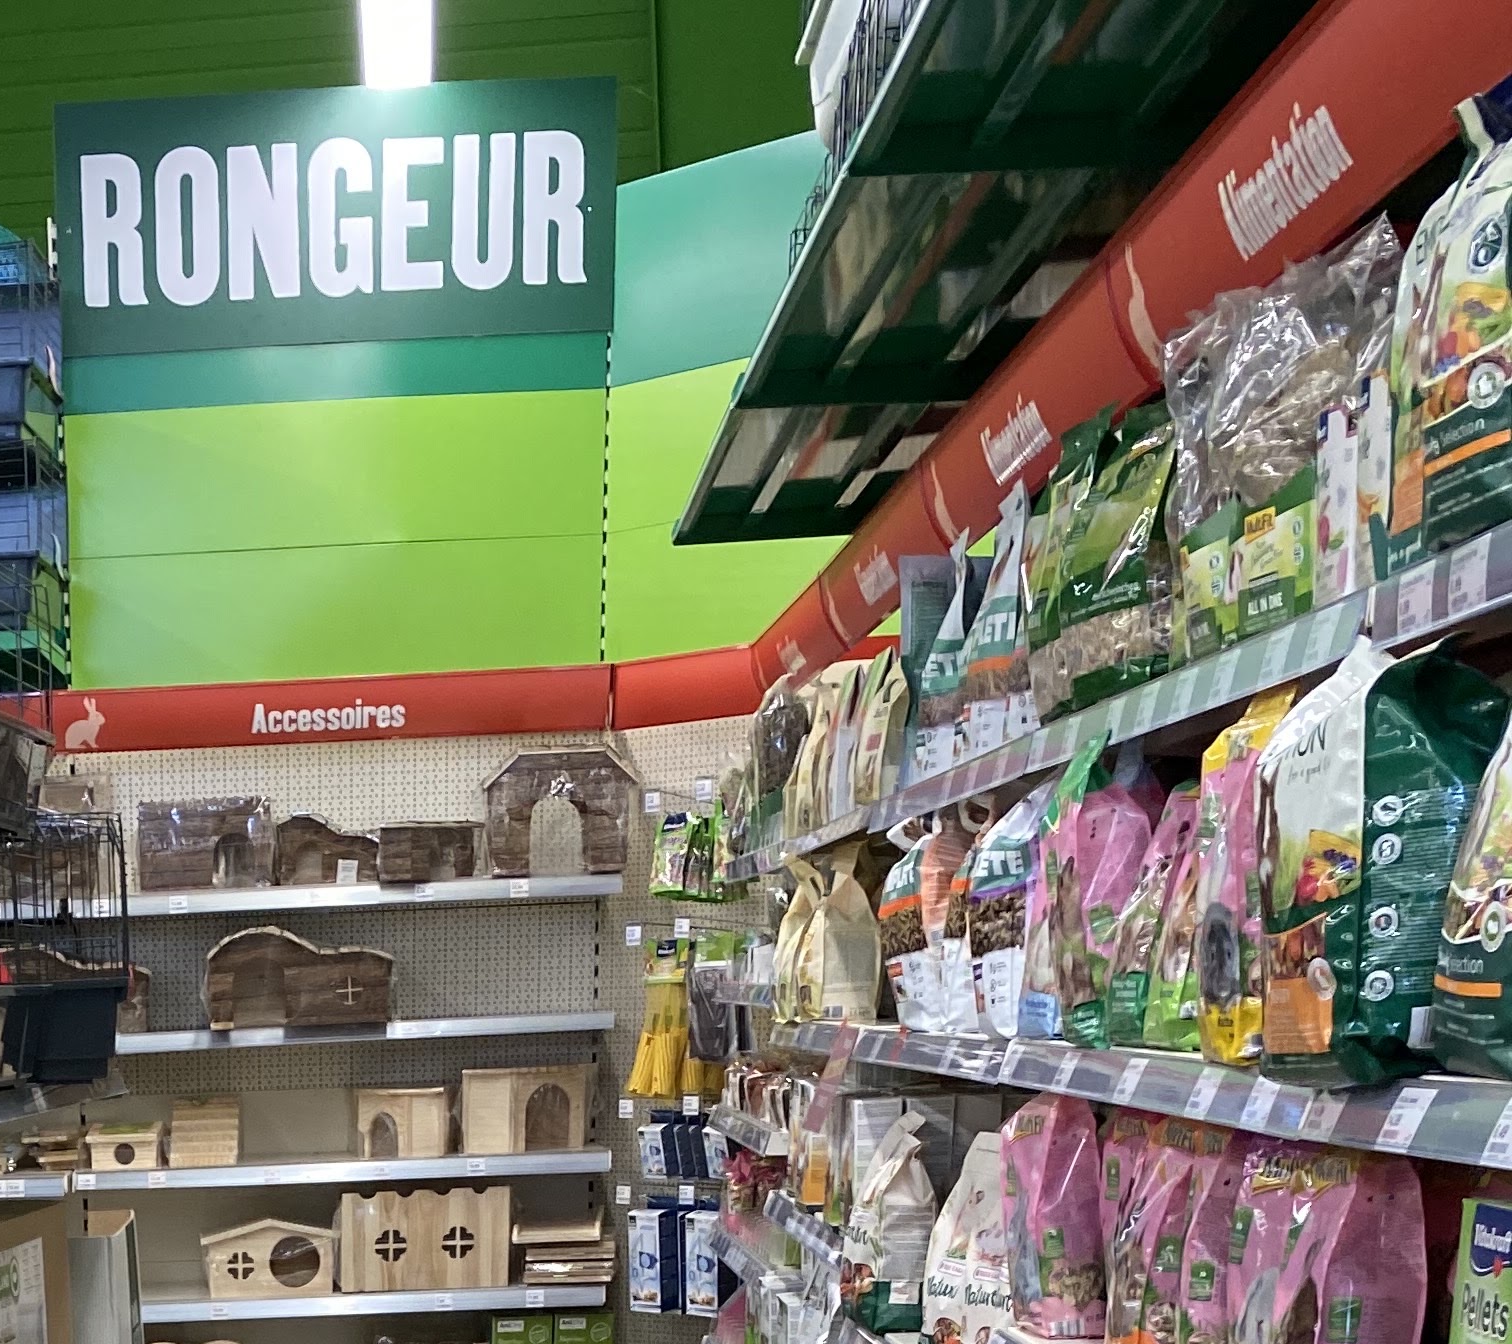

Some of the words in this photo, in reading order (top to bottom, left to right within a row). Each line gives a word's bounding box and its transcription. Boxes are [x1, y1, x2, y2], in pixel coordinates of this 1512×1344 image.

[79, 130, 589, 309] RONGEUR
[1218, 101, 1355, 262] Alimentation
[251, 698, 407, 735] Accessoires
[1460, 1282, 1511, 1342] Pellets
